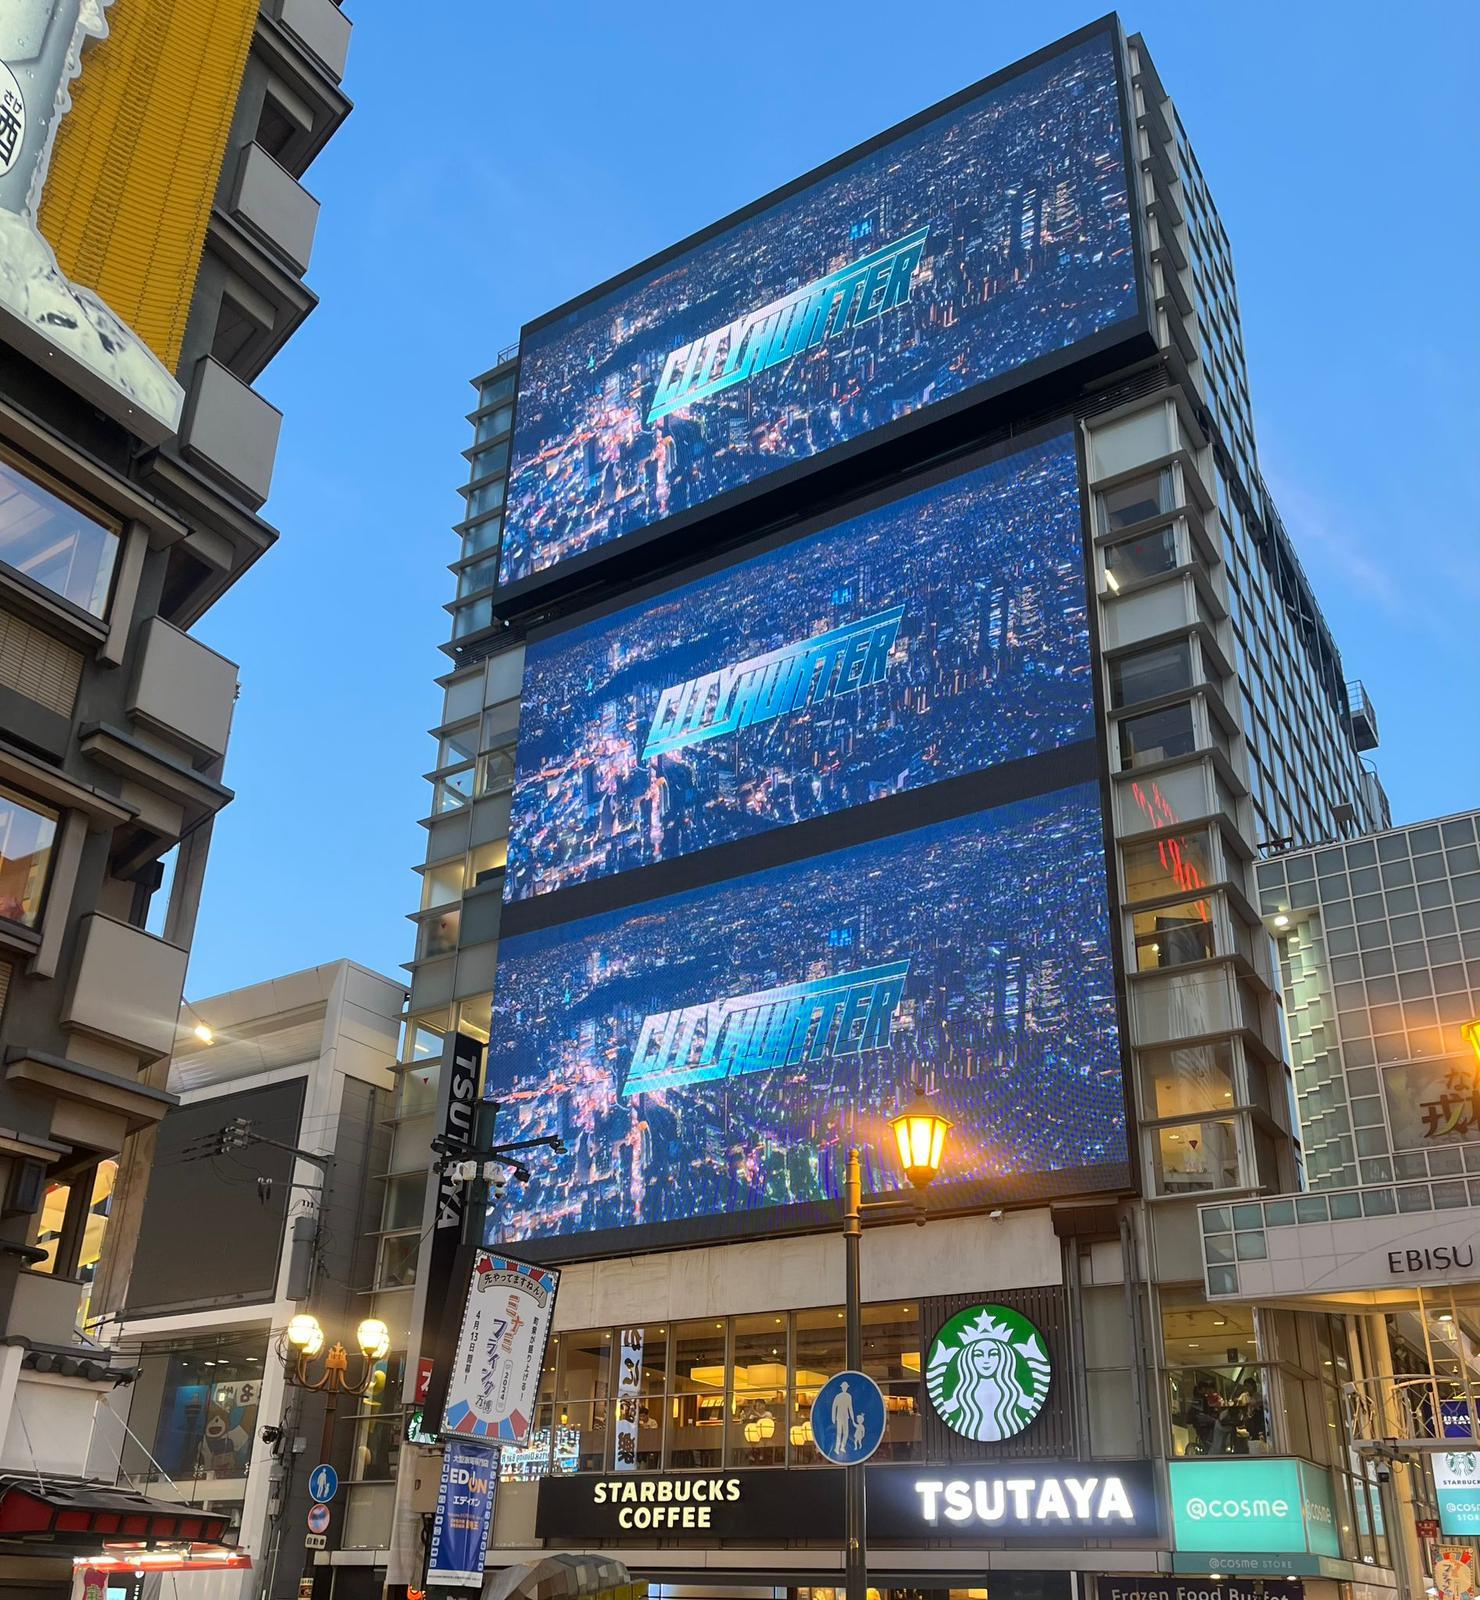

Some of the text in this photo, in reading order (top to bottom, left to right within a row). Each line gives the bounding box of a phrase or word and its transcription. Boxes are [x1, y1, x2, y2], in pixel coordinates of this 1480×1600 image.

[1388, 1245, 1473, 1274] EBISU
[450, 1467, 488, 1494] EDION
[594, 1479, 740, 1503] STARBUCKS
[915, 1478, 1134, 1521] TSUTAYA
[1186, 1497, 1289, 1520] @cosme
[619, 1507, 711, 1529] COFFEE
[1209, 1557, 1259, 1569] @cosme
[1177, 1587, 1221, 1600] Food
